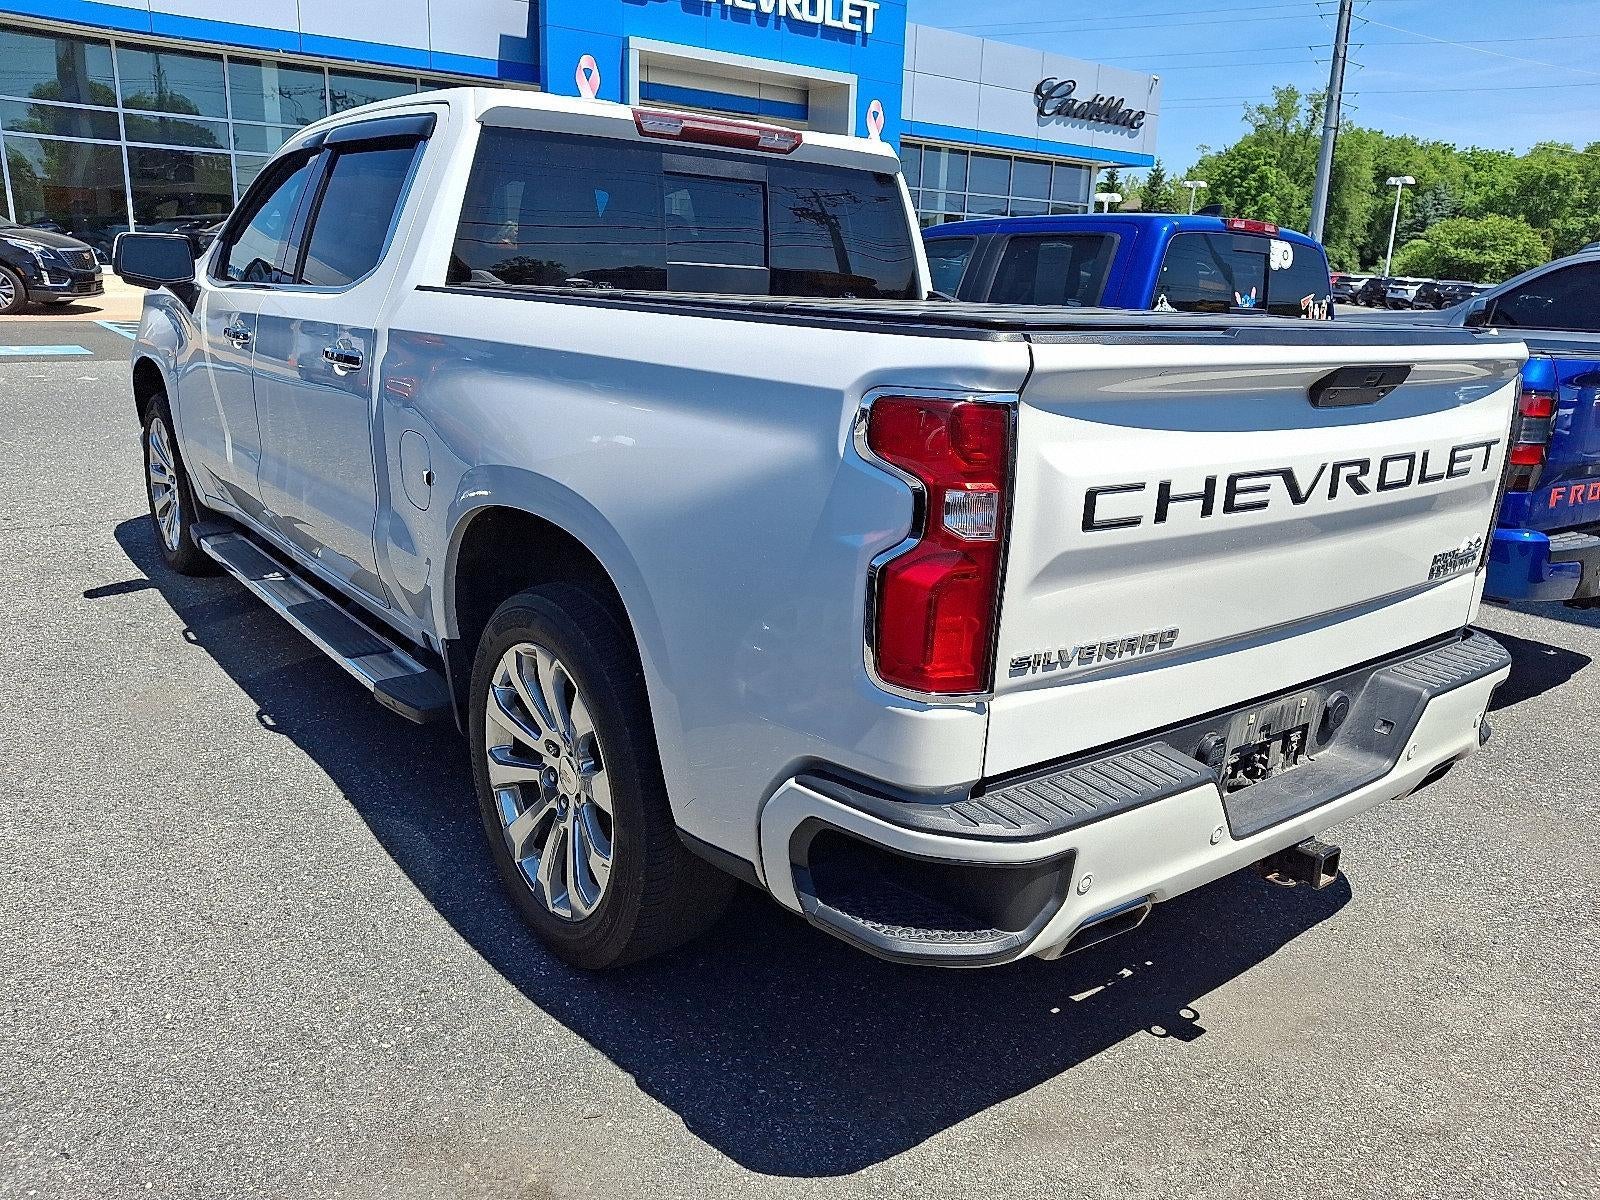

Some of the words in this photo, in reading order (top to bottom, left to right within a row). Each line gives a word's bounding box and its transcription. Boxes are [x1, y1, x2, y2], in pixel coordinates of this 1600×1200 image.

[1033, 77, 1146, 129] Cadillac
[1082, 438, 1500, 533] CHEVROLET
[1009, 628, 1180, 673] SILVERADO
